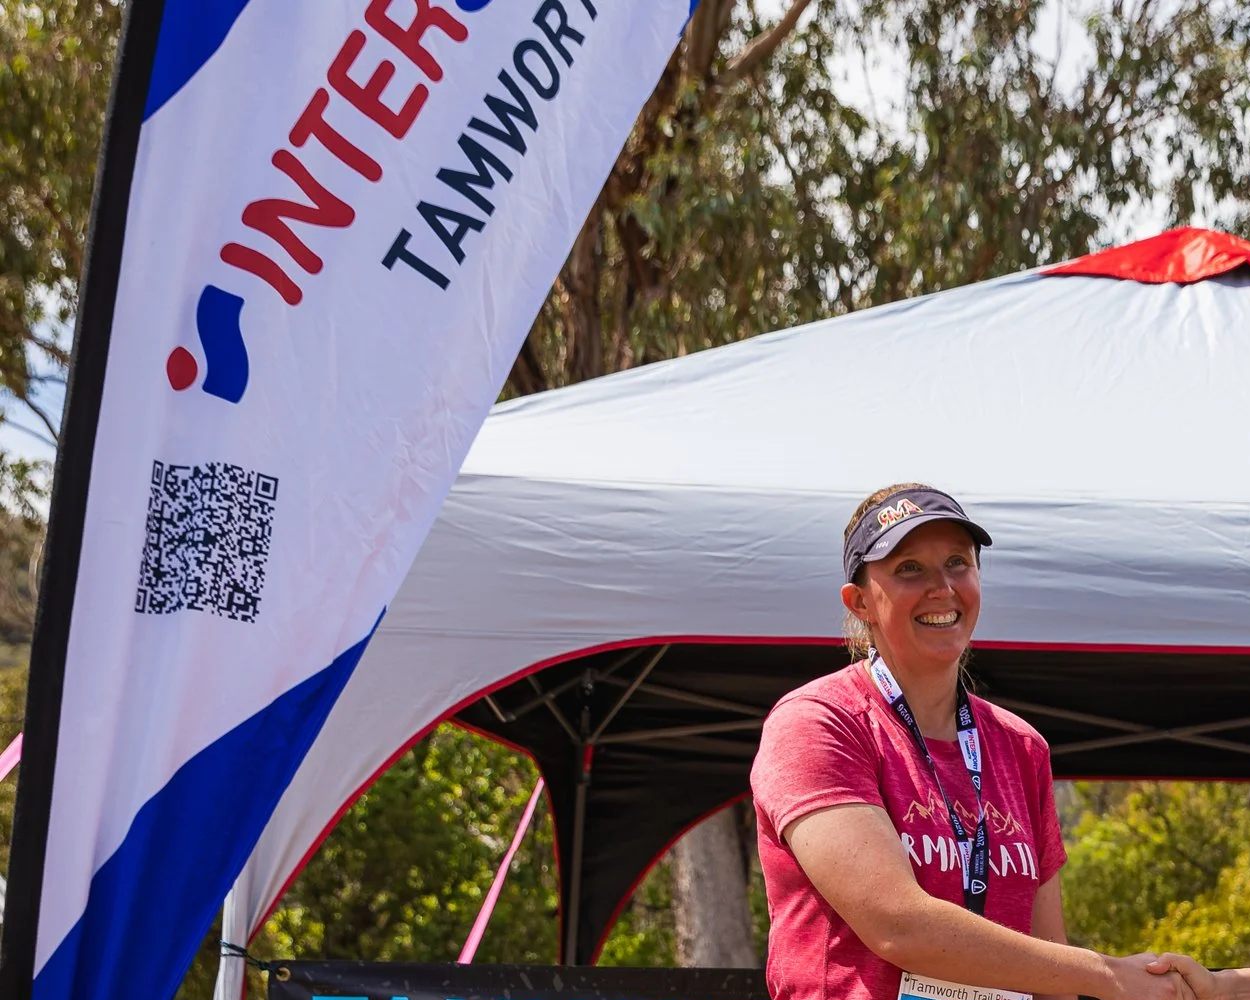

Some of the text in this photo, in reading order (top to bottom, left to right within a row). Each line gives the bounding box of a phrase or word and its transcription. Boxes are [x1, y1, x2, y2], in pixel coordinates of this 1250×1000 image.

[220, 0, 492, 306] INTER
[896, 703, 914, 726] 2026
[958, 704, 972, 726] 2026
[910, 978, 968, 1000] Tamworth
